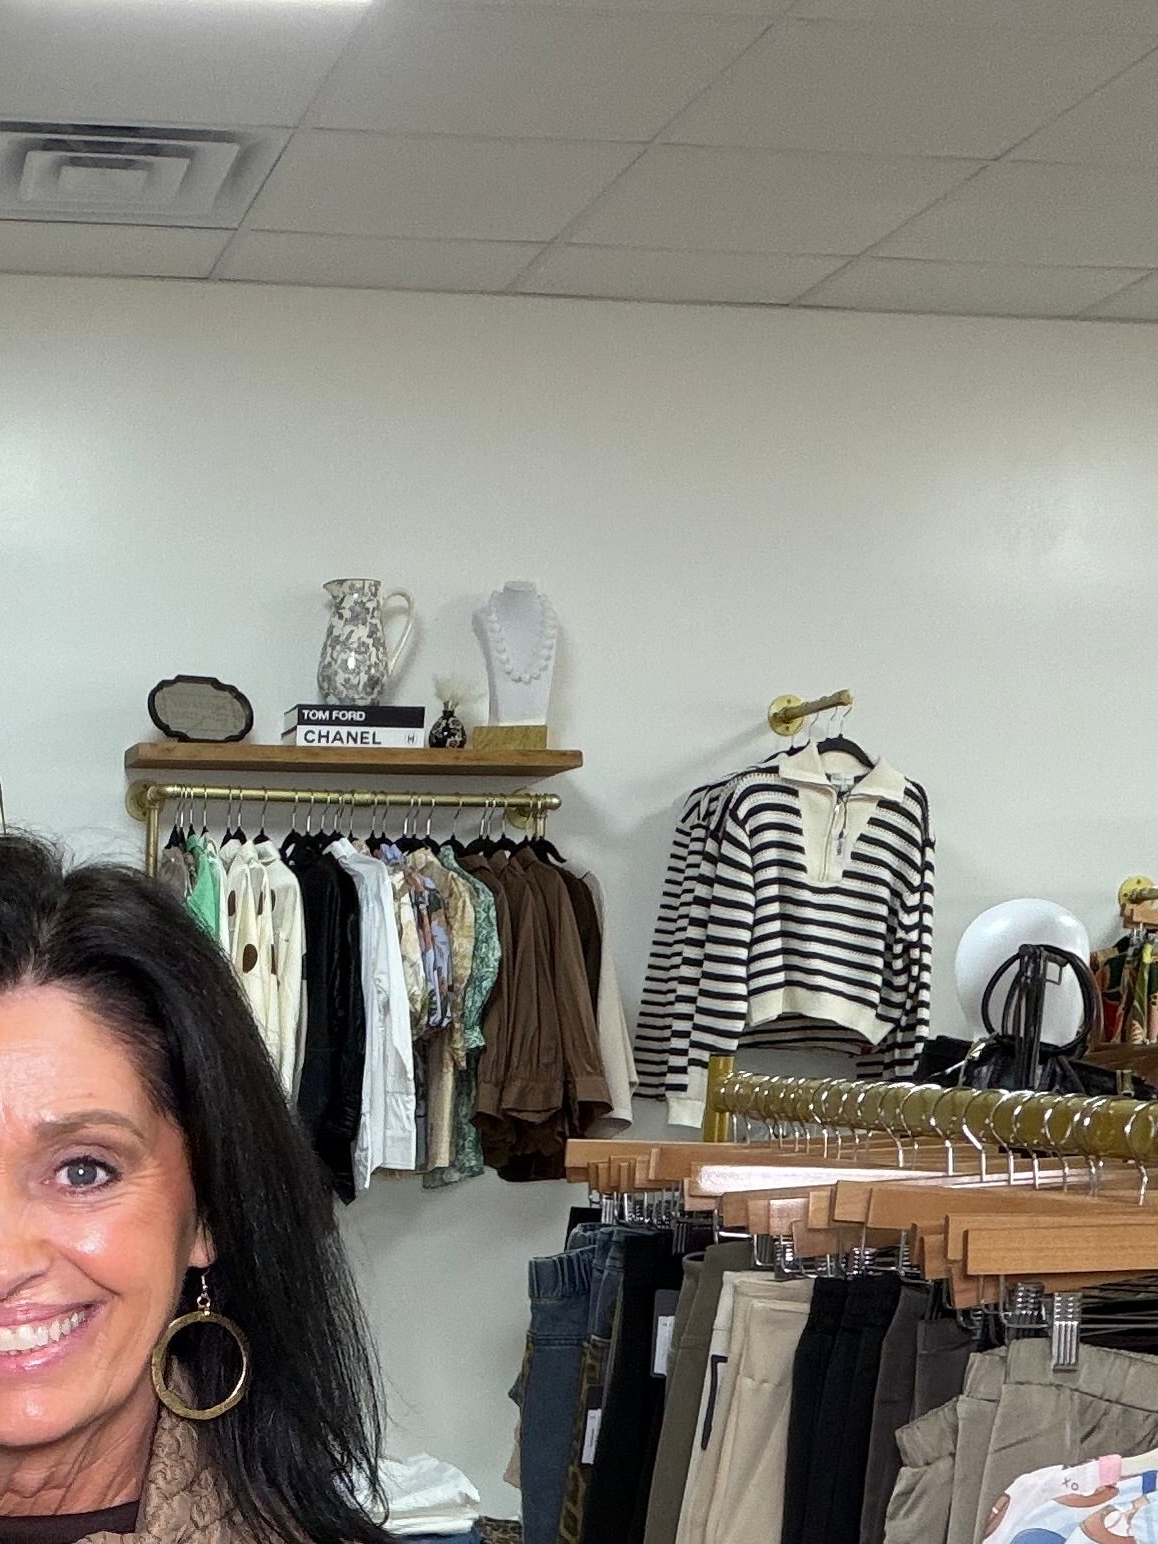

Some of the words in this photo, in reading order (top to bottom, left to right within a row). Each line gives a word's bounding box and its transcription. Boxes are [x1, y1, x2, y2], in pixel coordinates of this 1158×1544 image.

[302, 709, 330, 721] TOM
[332, 710, 366, 721] FORD
[303, 729, 382, 745] CHANEL
